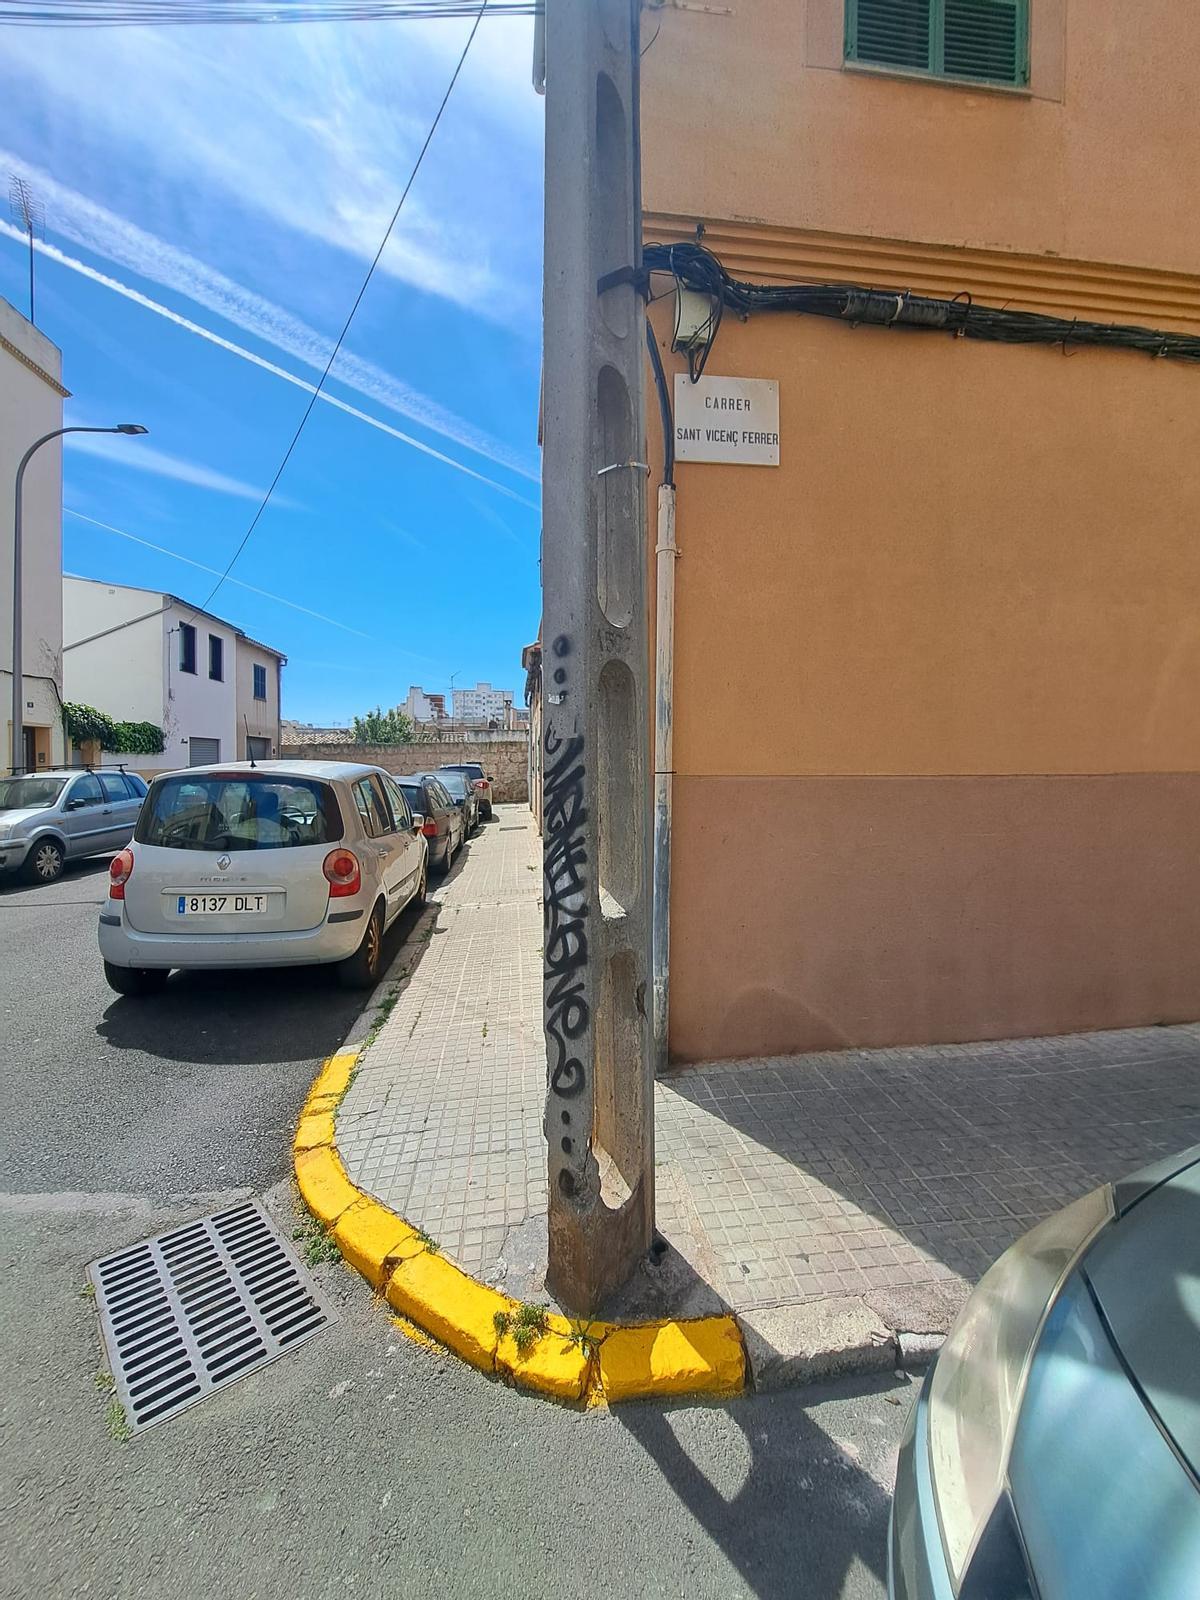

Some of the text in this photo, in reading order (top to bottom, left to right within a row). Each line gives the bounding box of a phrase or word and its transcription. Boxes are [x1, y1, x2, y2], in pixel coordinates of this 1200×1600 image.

[705, 397, 751, 411] CARRER
[677, 428, 779, 447] SANT VICENÇ FERRER
[190, 896, 263, 911] 8137 DLT
